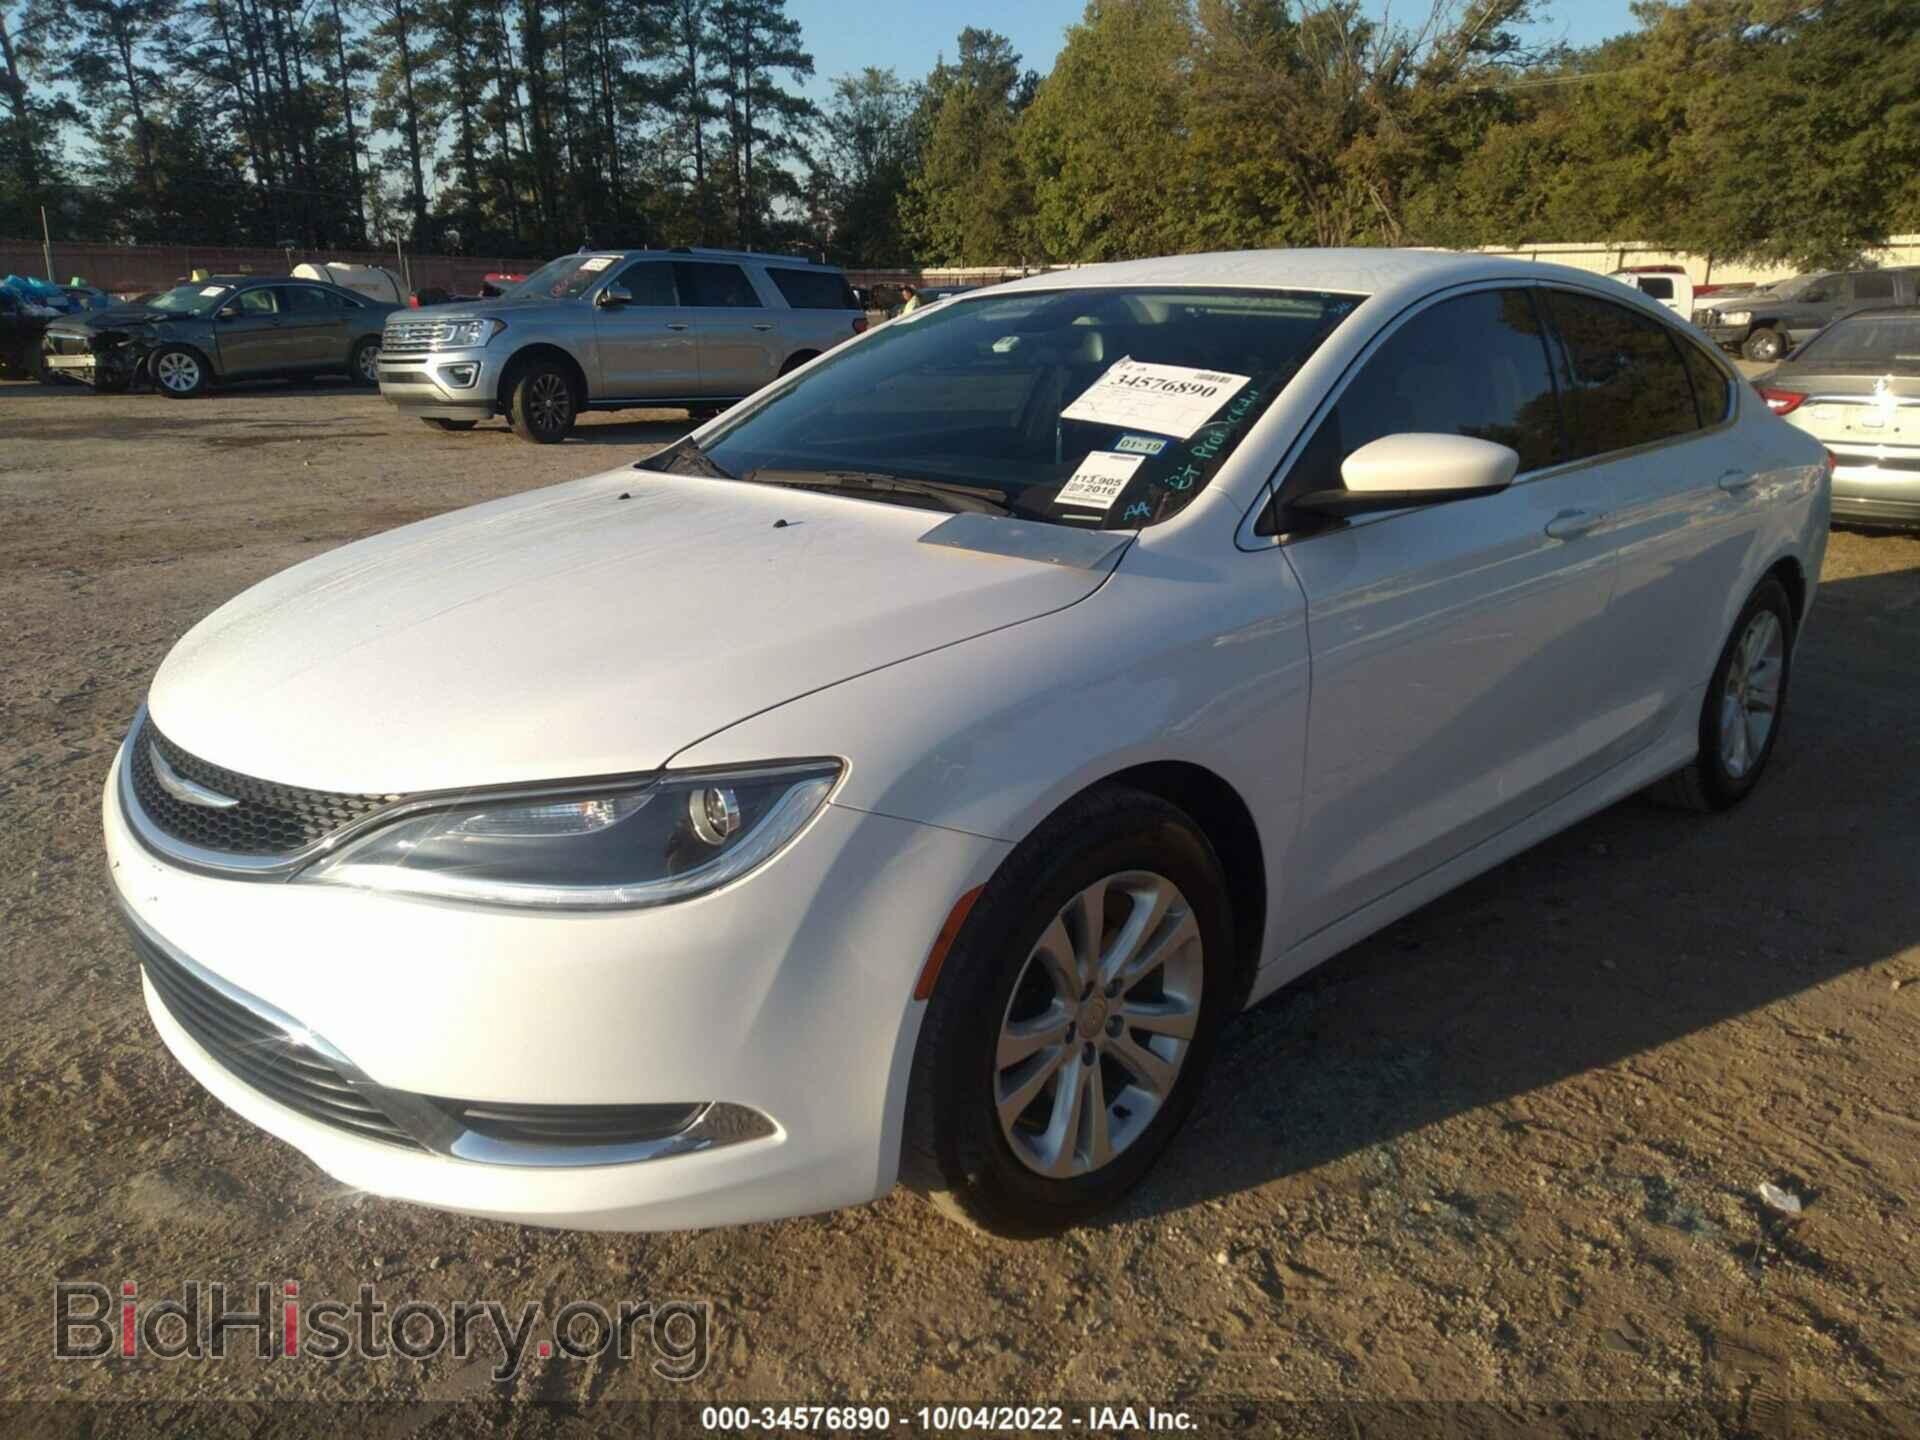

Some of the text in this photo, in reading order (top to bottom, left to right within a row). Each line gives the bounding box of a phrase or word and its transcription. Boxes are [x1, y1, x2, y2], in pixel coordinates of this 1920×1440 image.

[1110, 374, 1219, 398] 34576890
[1073, 474, 1123, 486] 113,905
[1084, 484, 1117, 495] 2016
